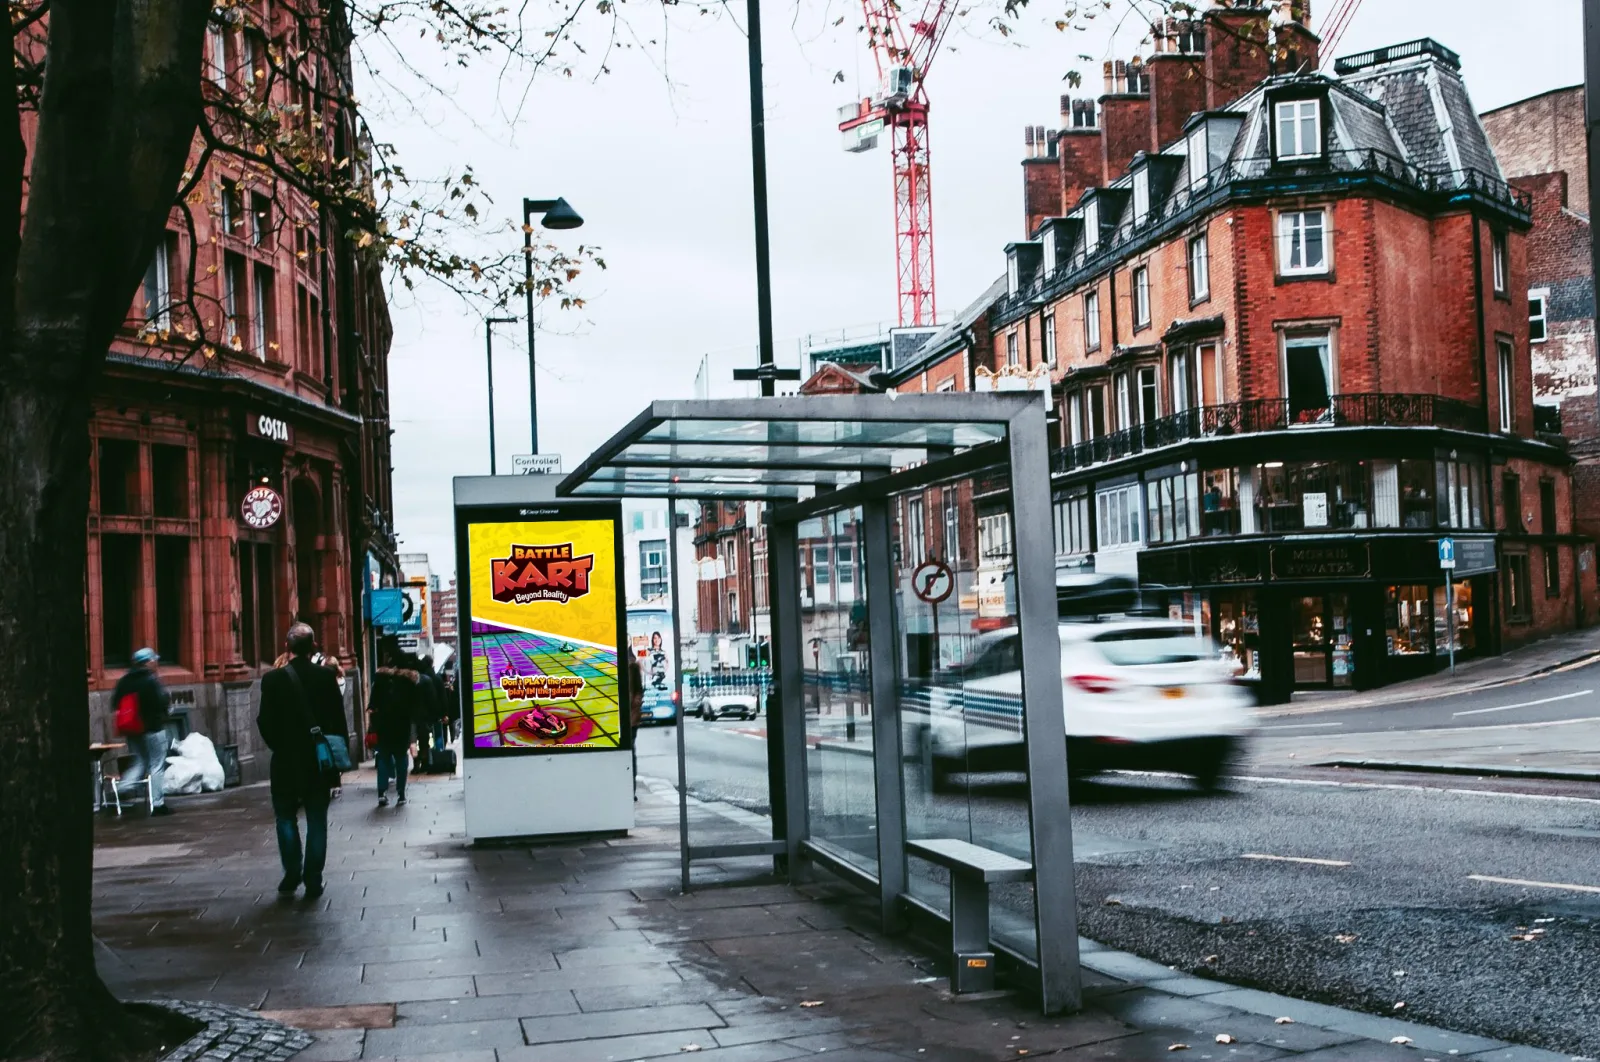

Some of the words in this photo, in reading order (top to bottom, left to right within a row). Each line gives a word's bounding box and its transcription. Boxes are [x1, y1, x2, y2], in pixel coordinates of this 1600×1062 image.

[258, 415, 289, 441] COSTA
[247, 489, 275, 503] COSTA
[245, 511, 279, 526] COFFEE
[514, 546, 570, 559] BATTLE
[493, 557, 591, 595] KART
[515, 590, 542, 602] Beyond
[542, 589, 568, 602] Reality
[524, 677, 546, 686] PLAY
[548, 677, 560, 685] the
[509, 687, 525, 697] play
[526, 687, 536, 695] IN
[537, 687, 550, 695] the
